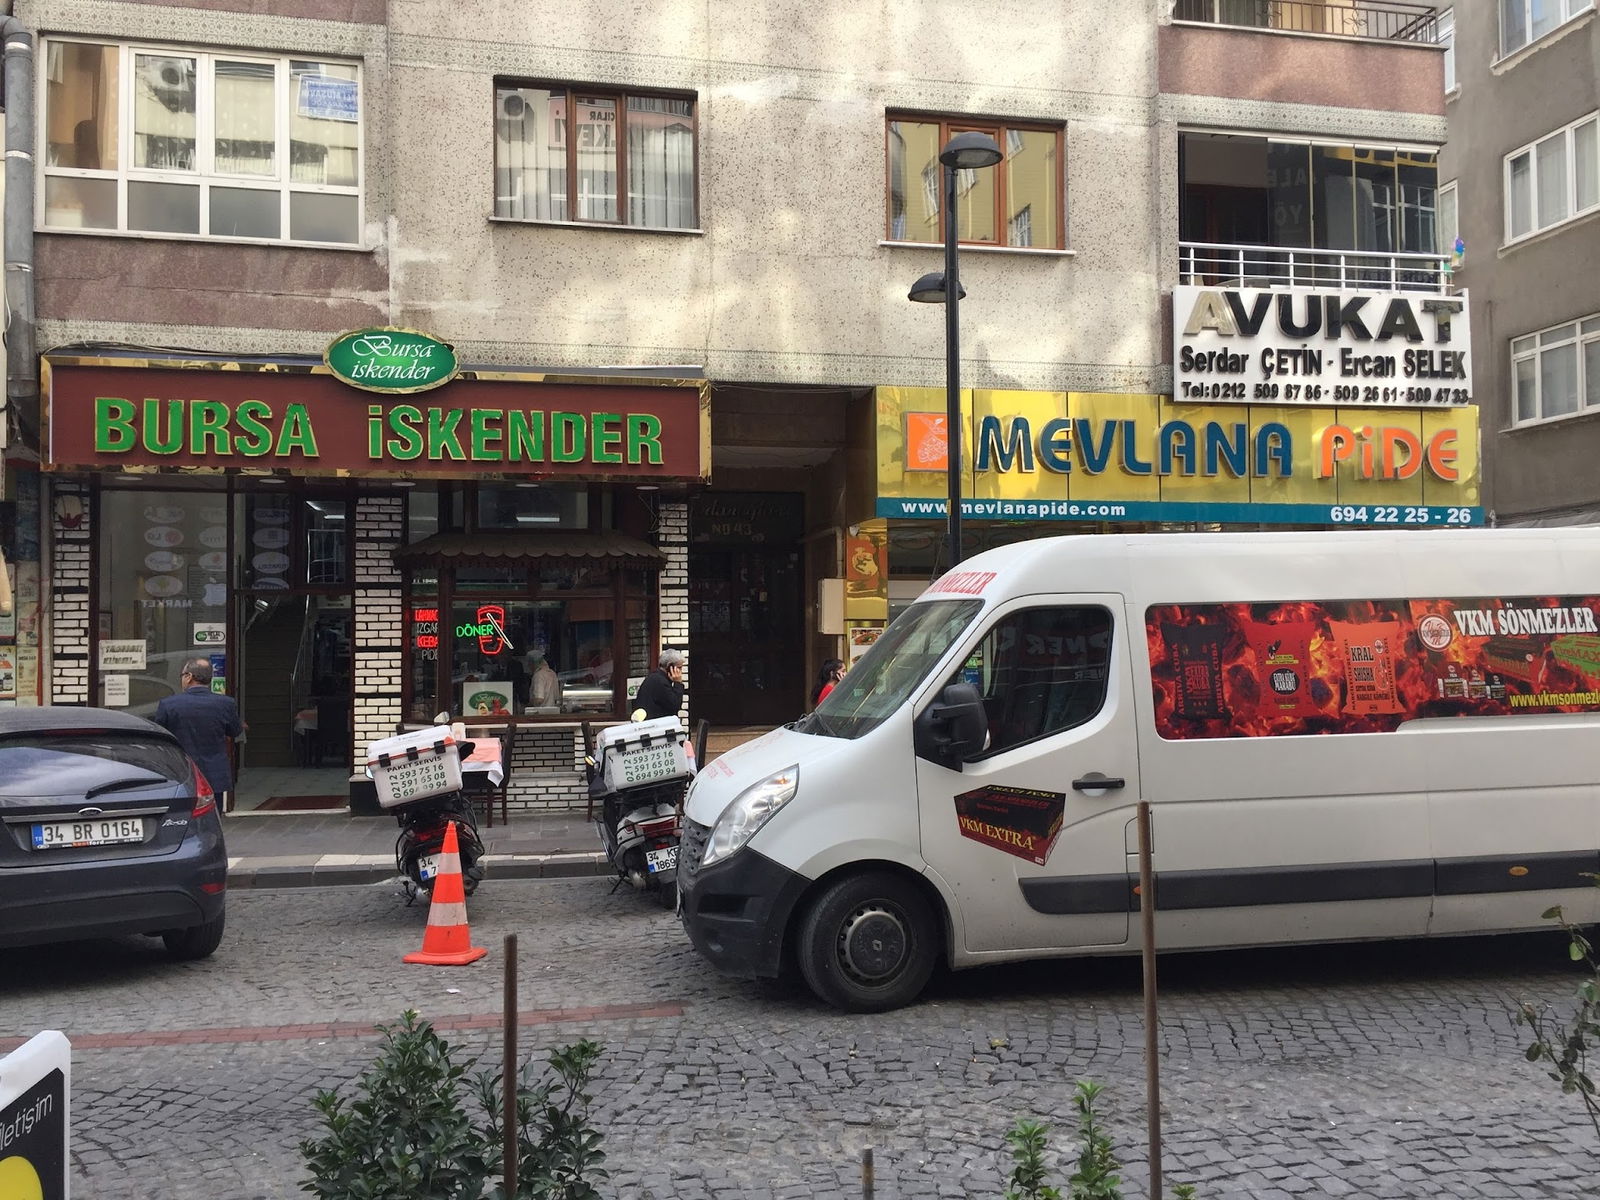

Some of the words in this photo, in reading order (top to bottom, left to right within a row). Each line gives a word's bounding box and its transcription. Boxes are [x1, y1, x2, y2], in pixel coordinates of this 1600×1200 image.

[1183, 290, 1464, 343] AVUKAT
[352, 334, 436, 358] Bursa
[351, 358, 436, 380] iskender
[1180, 345, 1249, 374] Serdar
[1261, 343, 1322, 380] ÇETİN
[1340, 347, 1396, 378] Ercan
[1403, 348, 1467, 380] SELEK
[1254, 383, 1279, 399] 509
[1333, 385, 1360, 401] 509
[95, 397, 320, 457] BURSA
[975, 415, 1294, 479] MEVLANA
[901, 501, 1126, 518] wwwmevlanapide.com
[1330, 506, 1368, 523] 694
[1374, 507, 1400, 523] 22
[1405, 508, 1429, 524] 25
[1447, 508, 1471, 524] 26
[1454, 608, 1497, 637] VKM
[1497, 602, 1599, 636] SÖNMEZLER
[456, 623, 495, 638] DÖNER
[1350, 646, 1374, 662] KRAL
[622, 748, 646, 757] PAKET
[633, 756, 649, 765] 593
[651, 753, 662, 761] 75
[664, 750, 674, 759] 16
[387, 762, 412, 773] PAKET
[400, 769, 417, 780] 593
[419, 766, 430, 776] 75
[433, 763, 444, 773] 16
[634, 763, 650, 773] 591
[664, 758, 675, 767] 08
[636, 770, 652, 781] 694
[666, 766, 676, 775] 94
[434, 771, 446, 780] 08
[436, 779, 448, 788] 94
[44, 825, 64, 842] 34
[73, 824, 93, 840] BR
[101, 820, 140, 838] 0164
[959, 817, 984, 836] VKM
[984, 825, 1035, 851] EXTRA
[648, 852, 659, 862] 34
